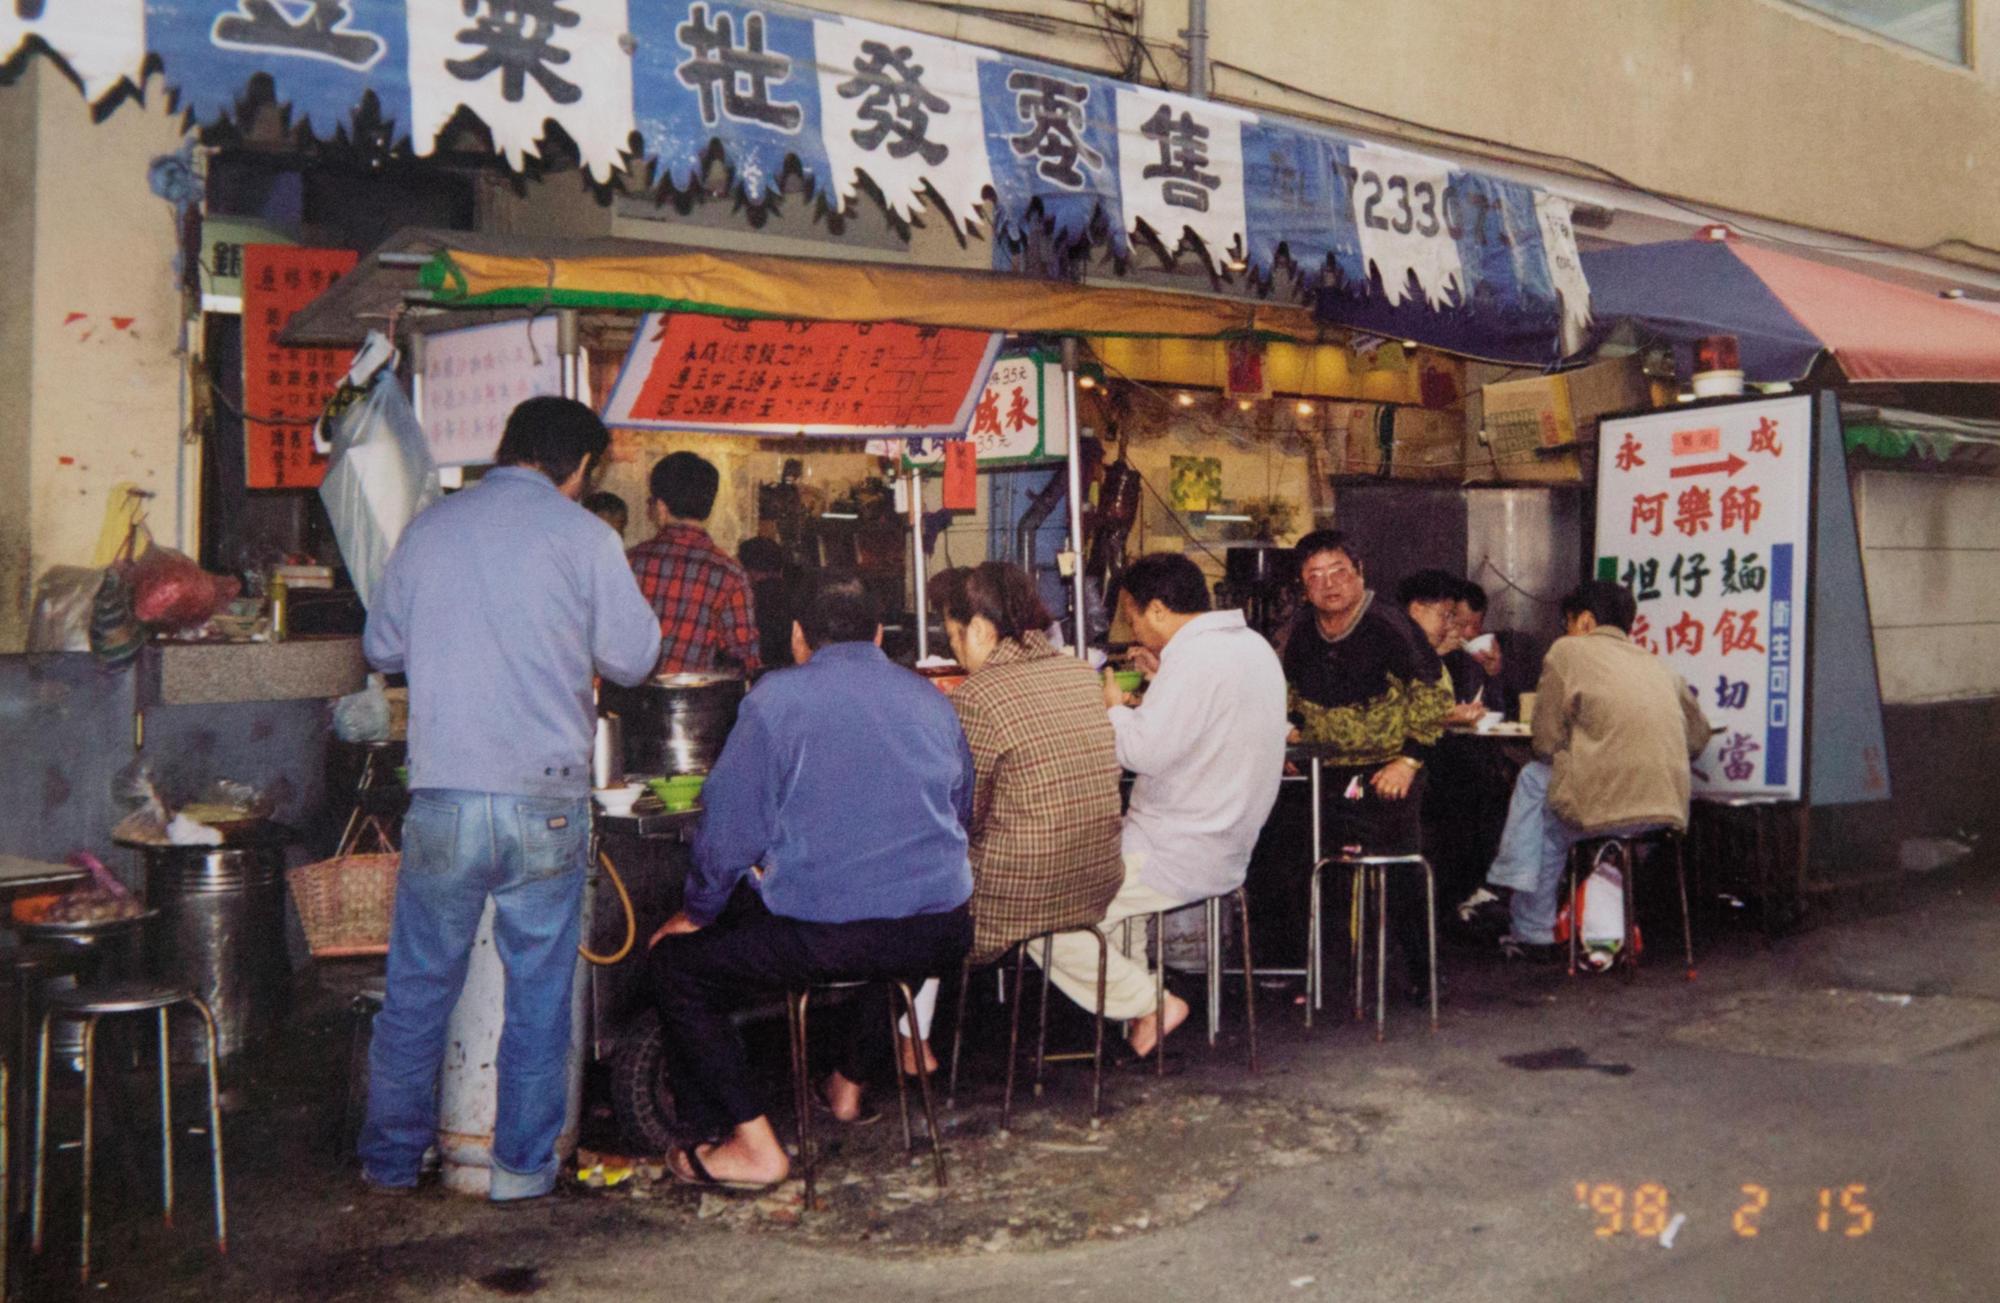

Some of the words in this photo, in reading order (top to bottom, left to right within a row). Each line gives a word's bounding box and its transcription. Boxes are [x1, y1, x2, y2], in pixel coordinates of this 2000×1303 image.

[1630, 484, 1762, 537] 阿樂師
[1691, 733, 1761, 782] 當
